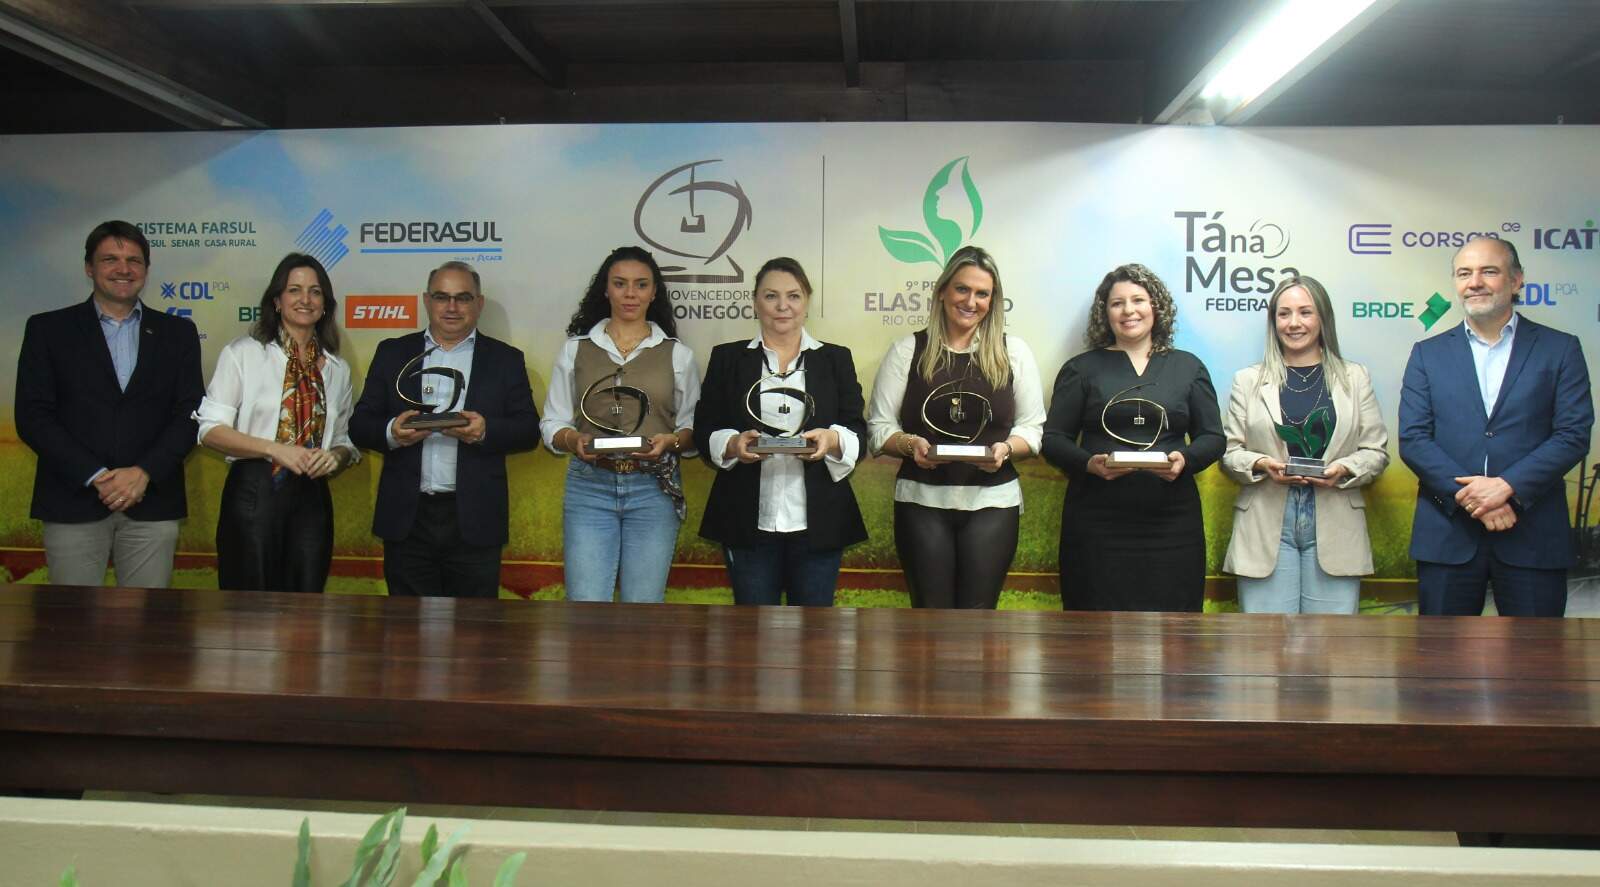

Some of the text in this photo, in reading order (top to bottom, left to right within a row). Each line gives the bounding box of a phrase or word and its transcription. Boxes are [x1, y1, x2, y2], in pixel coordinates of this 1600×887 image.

[136, 221, 257, 235] SISTEMA FARSUL
[360, 221, 503, 243] FEDERASUL
[1174, 211, 1265, 253] Tá na
[171, 239, 201, 248] SENAR
[204, 239, 227, 248] CASA
[228, 239, 257, 247] RURAL
[1533, 228, 1600, 250] ICAT
[179, 281, 214, 300] CDL
[864, 292, 922, 312] ELAS
[1205, 297, 1269, 312] FEDERA
[1352, 302, 1415, 318] BRDE
[352, 305, 410, 320] STIHL
[882, 315, 904, 326] RIO
